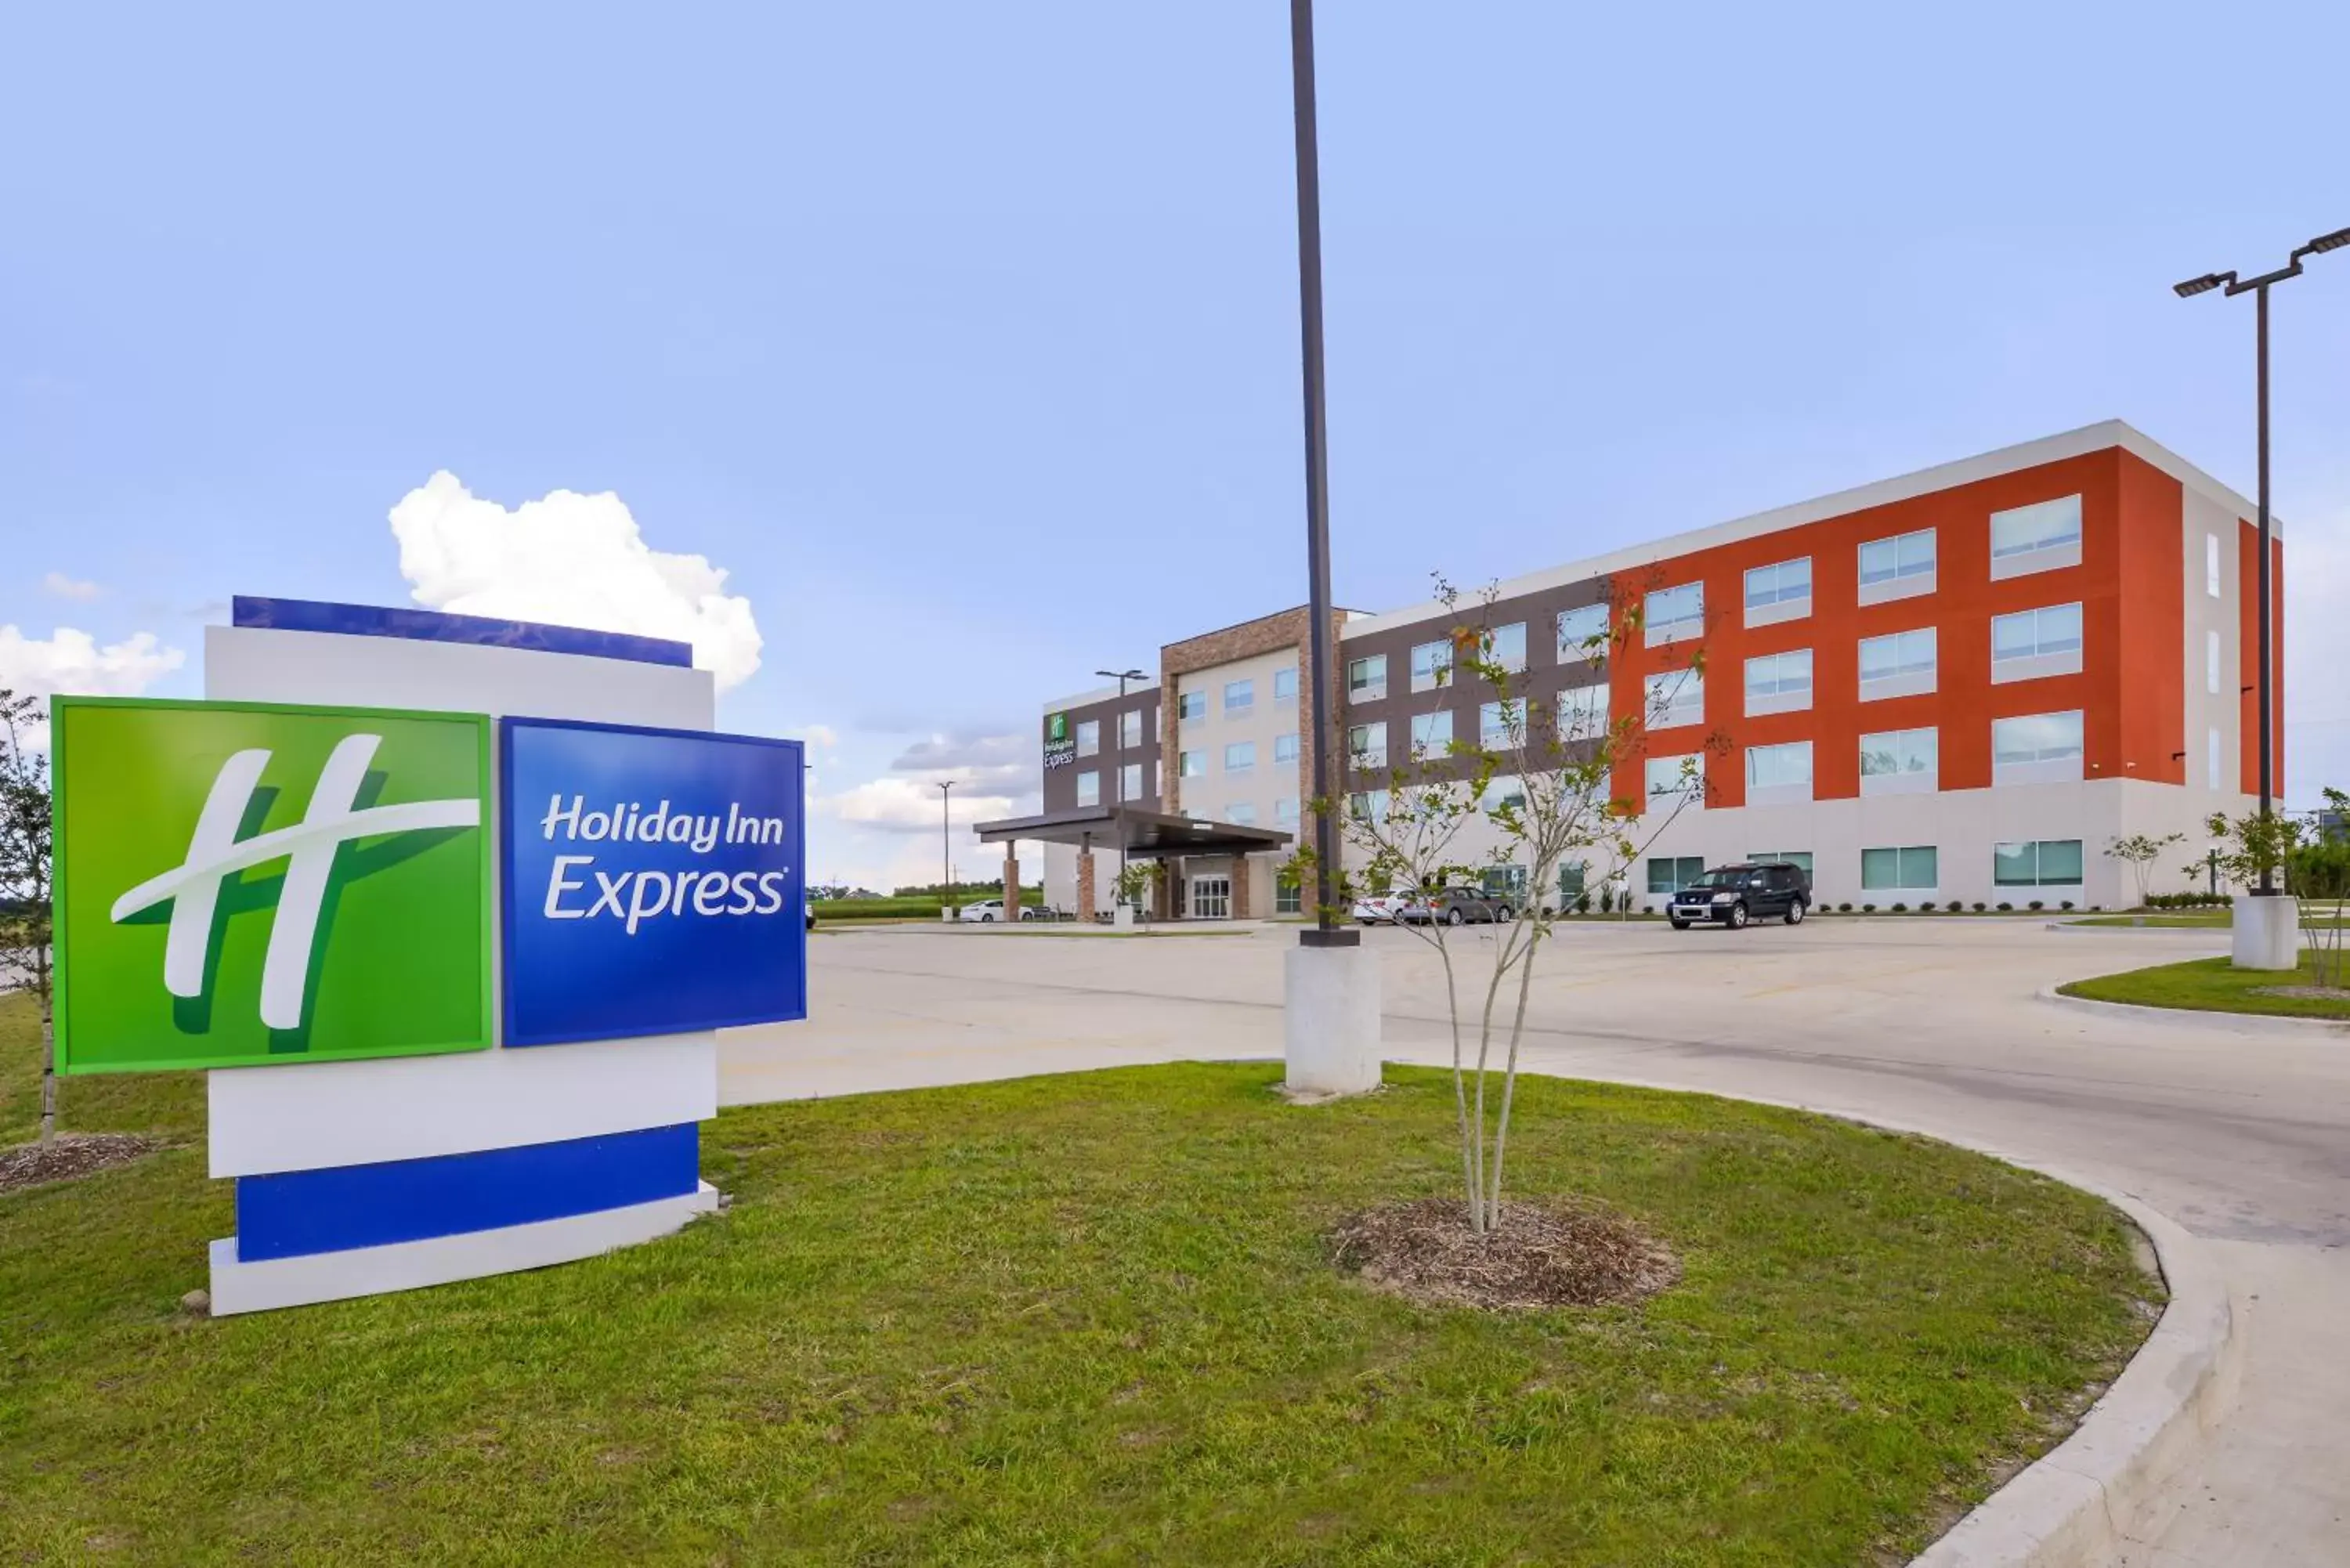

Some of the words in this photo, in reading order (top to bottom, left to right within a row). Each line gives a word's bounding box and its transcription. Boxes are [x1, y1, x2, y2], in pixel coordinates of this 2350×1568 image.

[540, 793, 719, 853] Holiday
[725, 802, 783, 844] Inn
[110, 734, 479, 1029] H
[544, 855, 786, 935] Express
